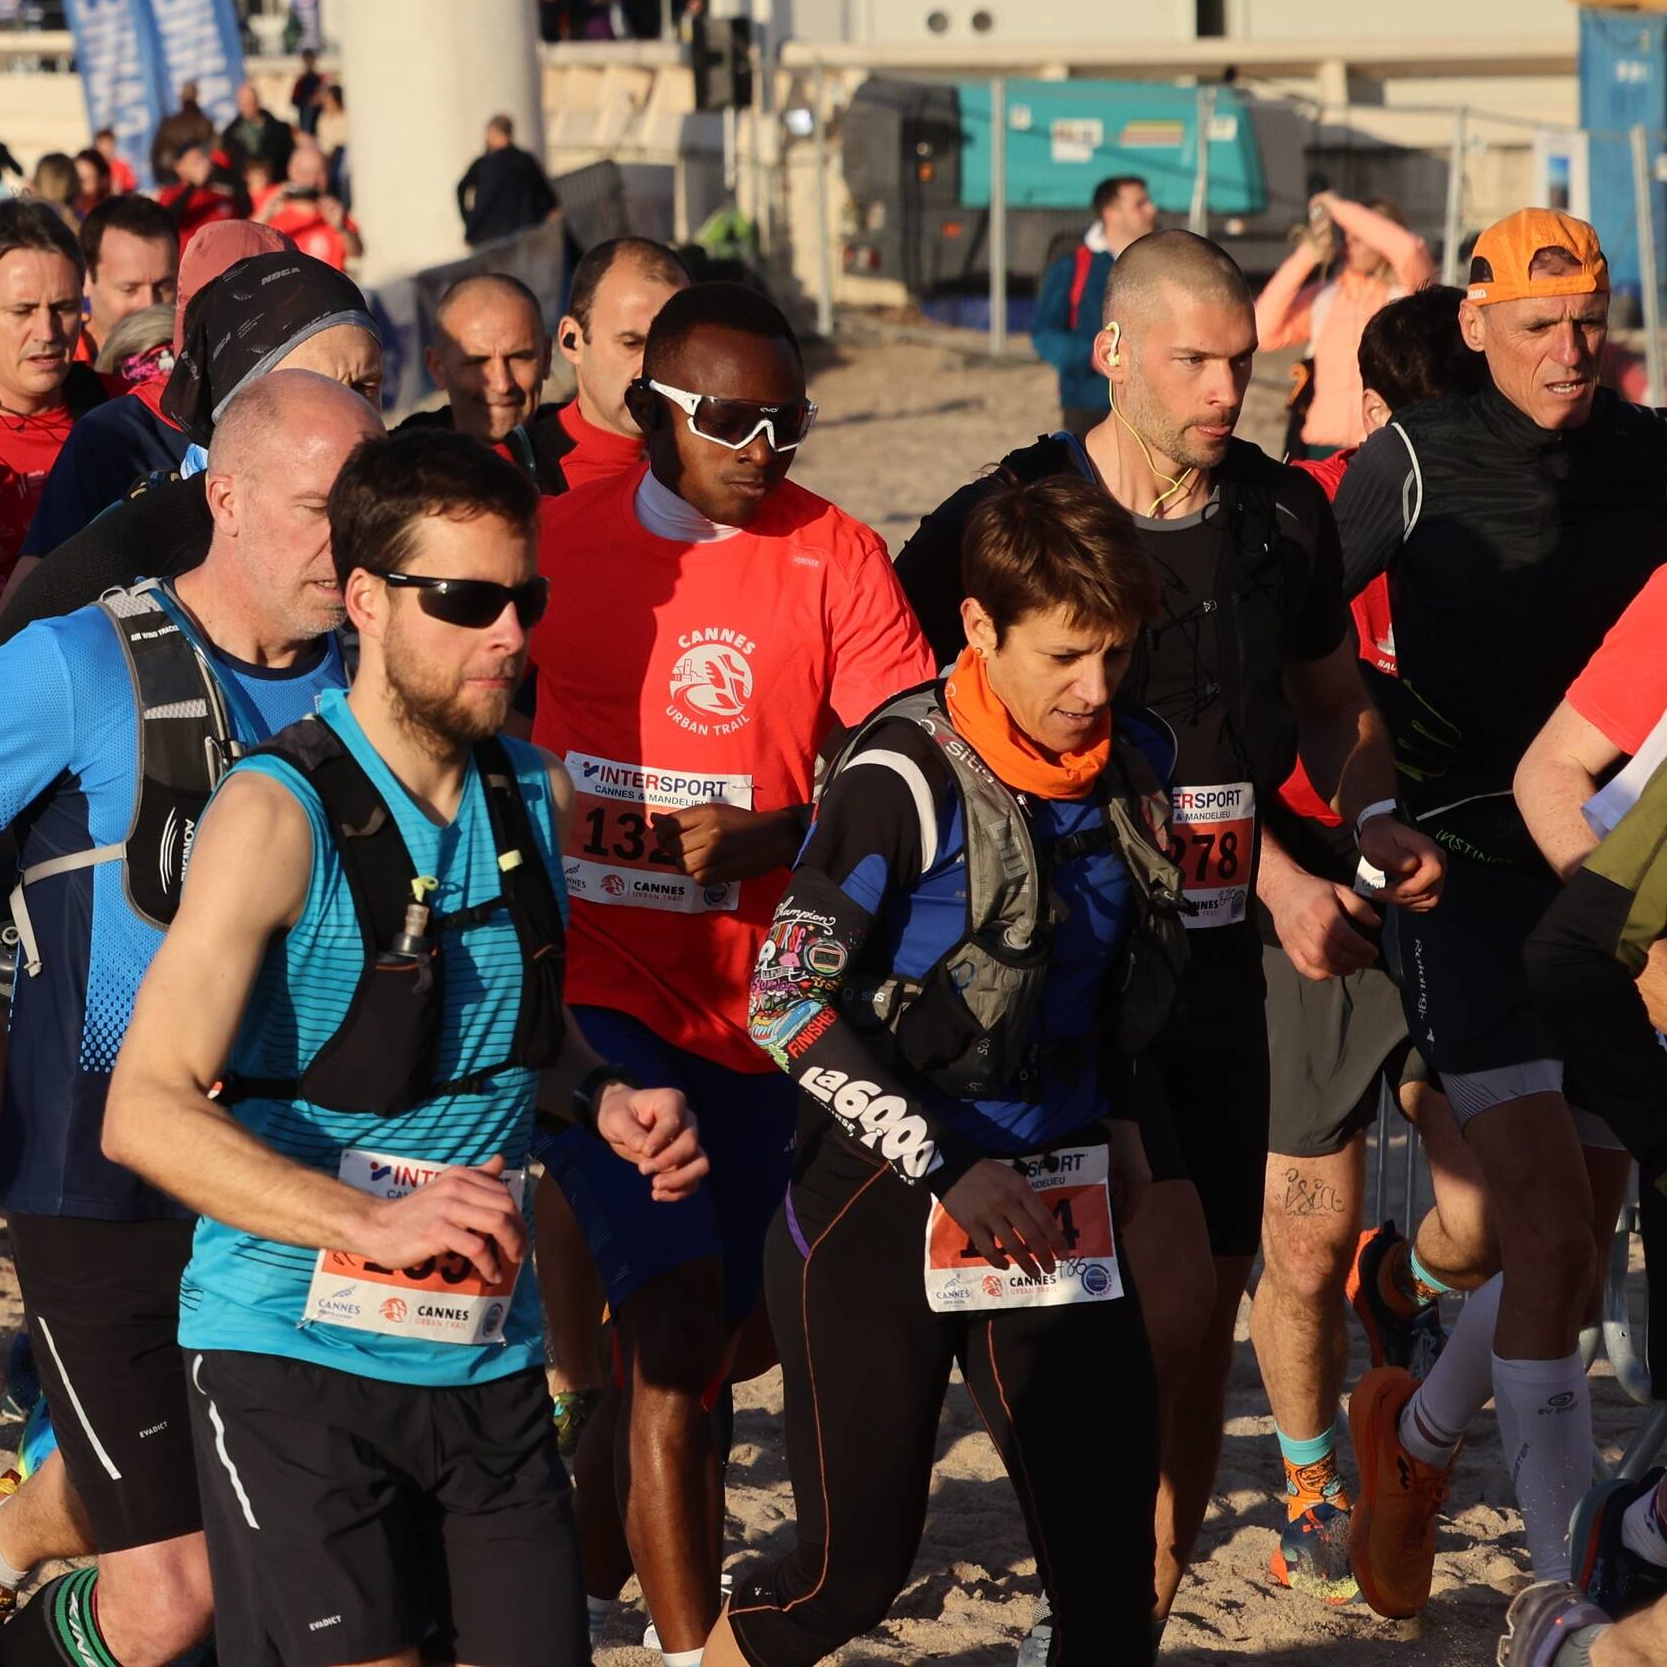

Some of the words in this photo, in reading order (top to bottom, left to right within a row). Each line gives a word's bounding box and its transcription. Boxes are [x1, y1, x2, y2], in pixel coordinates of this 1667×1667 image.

[678, 628, 755, 655] CANNES
[666, 705, 708, 736] URBAN
[712, 714, 751, 736] TRAIL
[600, 765, 727, 798] INTERSPORT
[595, 784, 635, 799] CANNES
[638, 793, 644, 801] &
[1185, 810, 1231, 821] MANDELIEU
[632, 891, 660, 900] URBAN
[633, 881, 686, 896] CANNES
[787, 1005, 840, 1060] FINISHER
[1009, 1274, 1057, 1287] CANNES
[936, 1289, 971, 1300] CANNES
[318, 1298, 361, 1314] CANNES
[417, 1305, 470, 1321] CANNES
[139, 1420, 168, 1438] EVADICT
[309, 1614, 343, 1632] EVADICT
